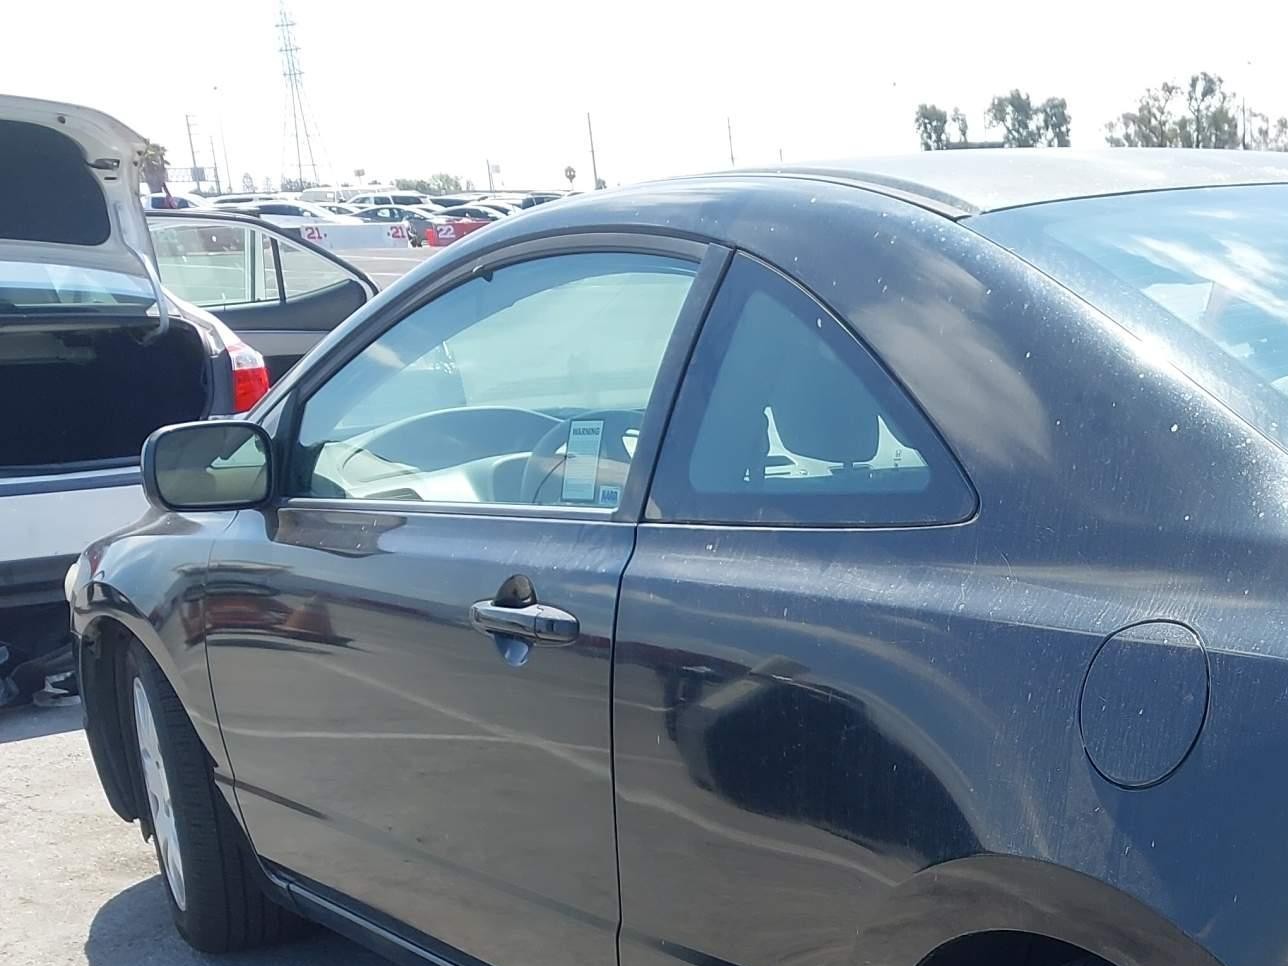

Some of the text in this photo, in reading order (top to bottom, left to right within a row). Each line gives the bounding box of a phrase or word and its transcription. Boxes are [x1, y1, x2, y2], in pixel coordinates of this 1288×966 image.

[304, 226, 323, 240] 21
[389, 225, 406, 239] 21
[437, 225, 456, 239] 22
